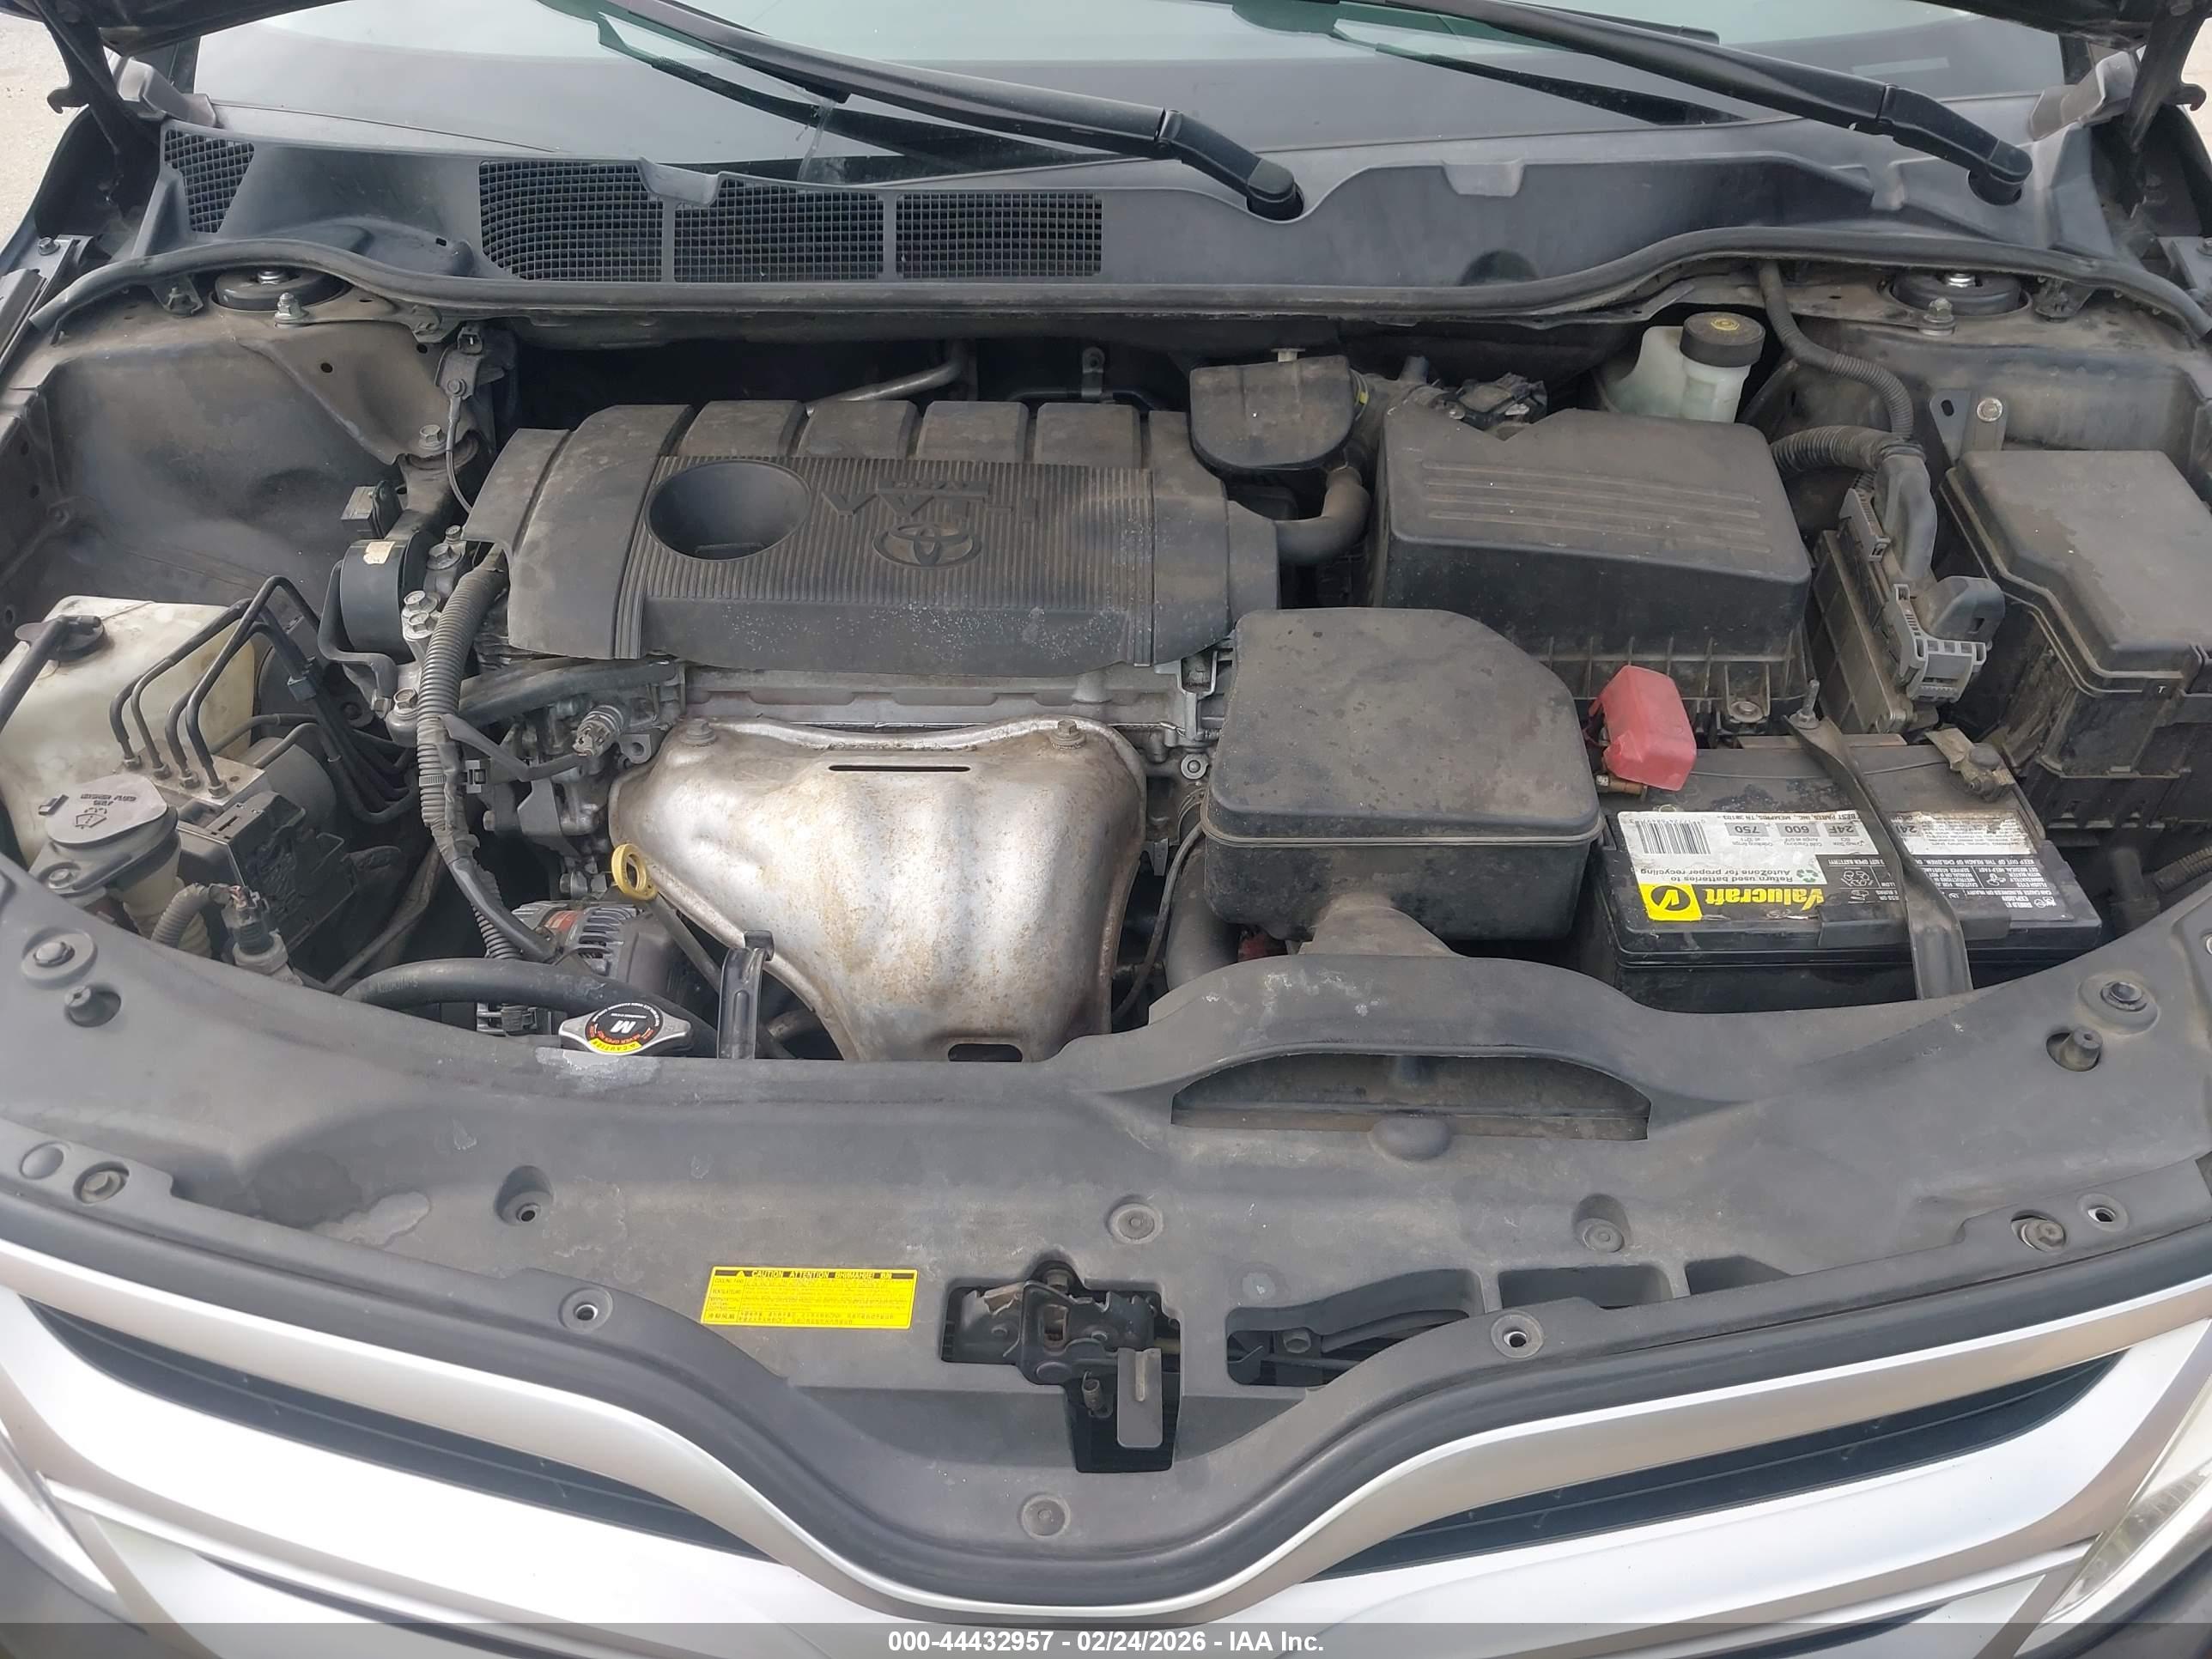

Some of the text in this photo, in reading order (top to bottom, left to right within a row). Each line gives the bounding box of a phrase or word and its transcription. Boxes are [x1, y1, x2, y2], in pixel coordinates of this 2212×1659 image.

[1828, 825, 1854, 834] 24F
[1705, 888, 1824, 911] Valucraft
[610, 1020, 636, 1034] M
[751, 1270, 829, 1279] CAUTION ATTENTION
